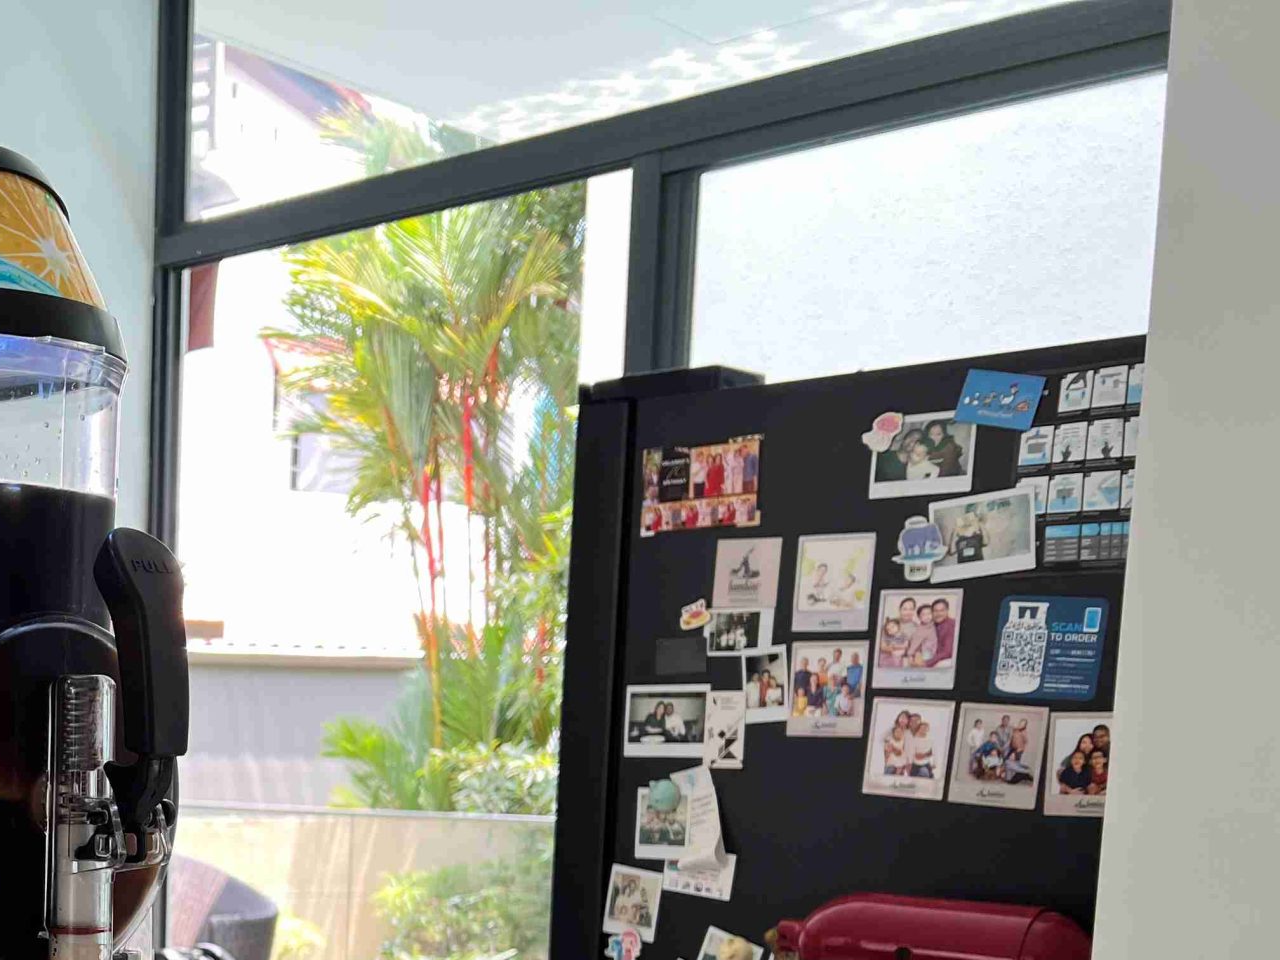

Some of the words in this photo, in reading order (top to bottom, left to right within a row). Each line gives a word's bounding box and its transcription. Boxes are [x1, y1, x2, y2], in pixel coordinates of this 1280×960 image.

[131, 559, 174, 574] PULL
[1051, 622, 1083, 632] SCAN
[1050, 632, 1063, 641] TO
[1064, 633, 1098, 643] ORDER
